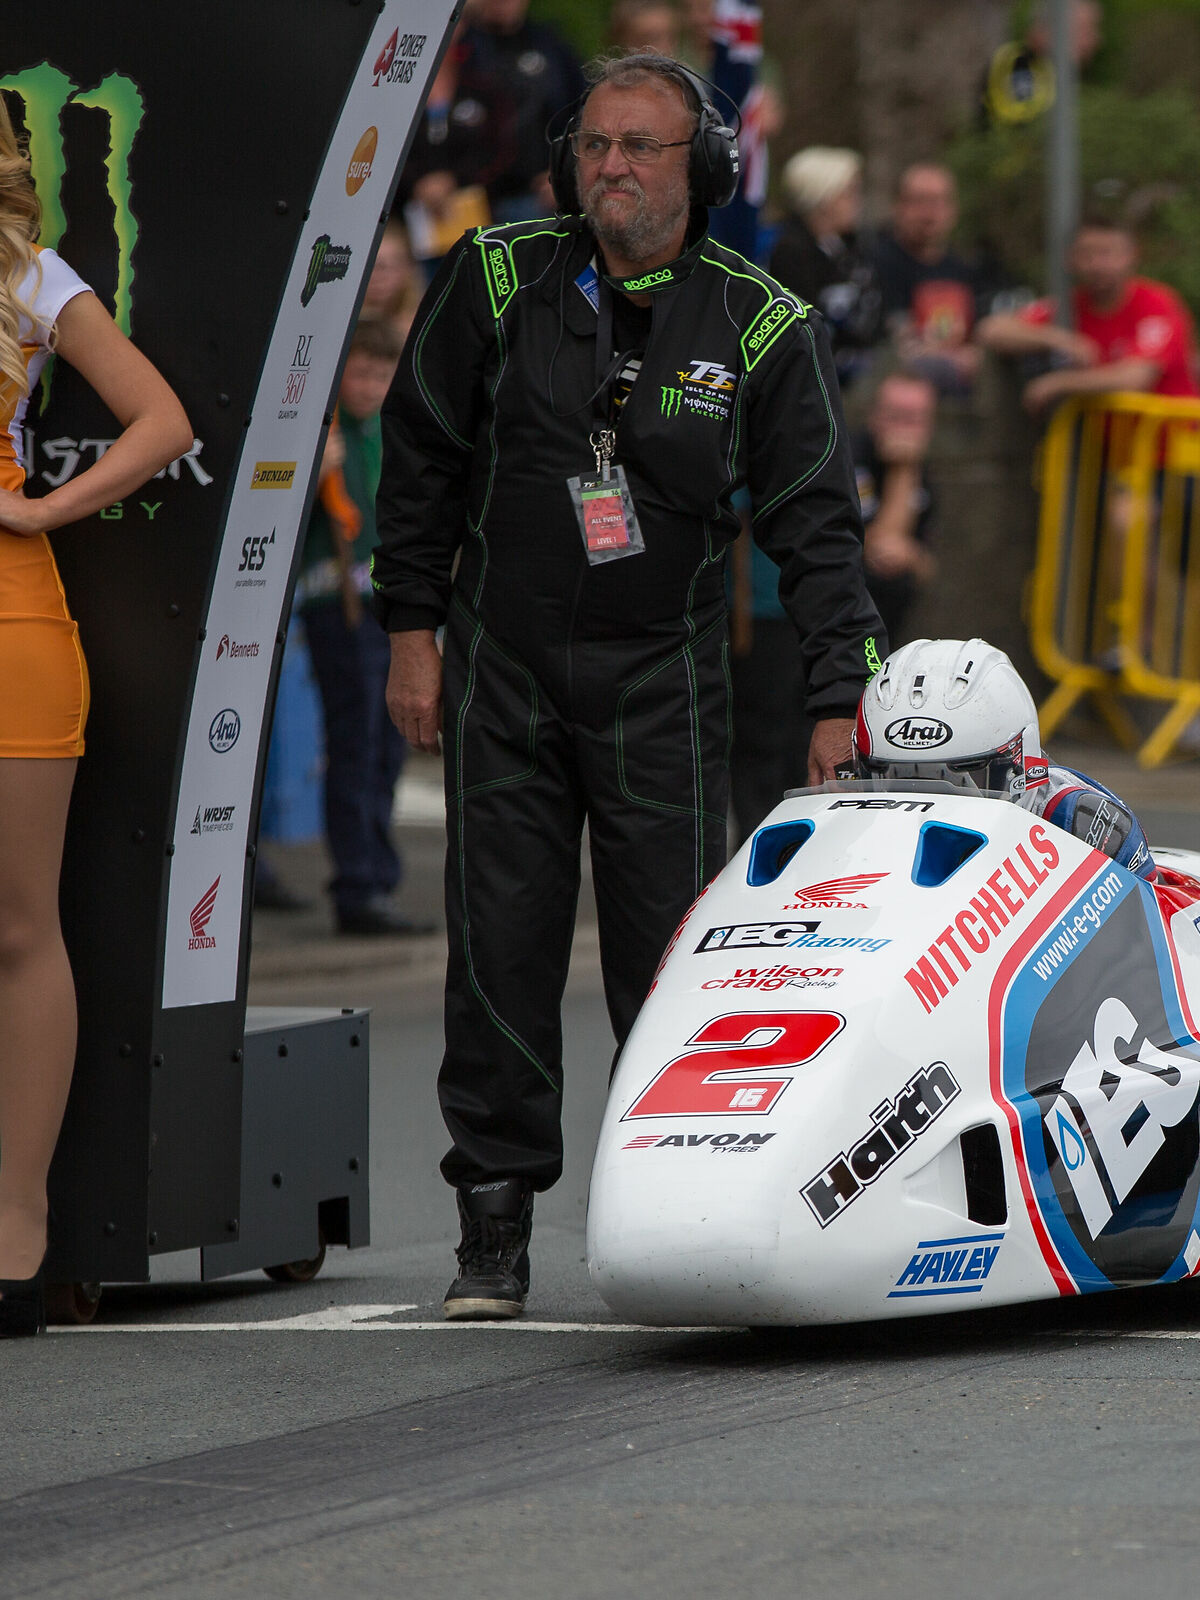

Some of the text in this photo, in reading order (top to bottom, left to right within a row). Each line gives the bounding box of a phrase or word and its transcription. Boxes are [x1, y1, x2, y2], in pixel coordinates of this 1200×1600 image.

[395, 33, 427, 58] POKER
[386, 60, 417, 84] STARS
[489, 248, 511, 298] sparco
[623, 268, 675, 292] sparco
[747, 303, 791, 352] sparco
[291, 334, 314, 367] RL
[689, 360, 737, 390] TT
[685, 385, 704, 395] ISLE
[705, 389, 717, 397] OF
[259, 470, 295, 483] DUNLOP
[238, 536, 268, 572] SES
[229, 641, 260, 658] Bennetts
[210, 713, 238, 741] Arai
[888, 720, 944, 741] Arai
[203, 806, 235, 823] WRYST
[202, 822, 234, 832] TIMEPIECES
[781, 901, 869, 911] HONDA
[903, 824, 1060, 1015] MITCHELLS
[1033, 871, 1123, 982] www.i-e-g.com
[188, 936, 216, 951] HONDA
[788, 933, 893, 953] Racing
[734, 964, 844, 978] wilson
[701, 977, 837, 991] craig Racing
[618, 1010, 847, 1122] 2
[728, 1087, 769, 1108] 16
[654, 1133, 777, 1148] AVON
[711, 1146, 761, 1154] TYRES
[801, 1062, 961, 1229] Haith
[895, 1245, 1001, 1287] HAYLEY
